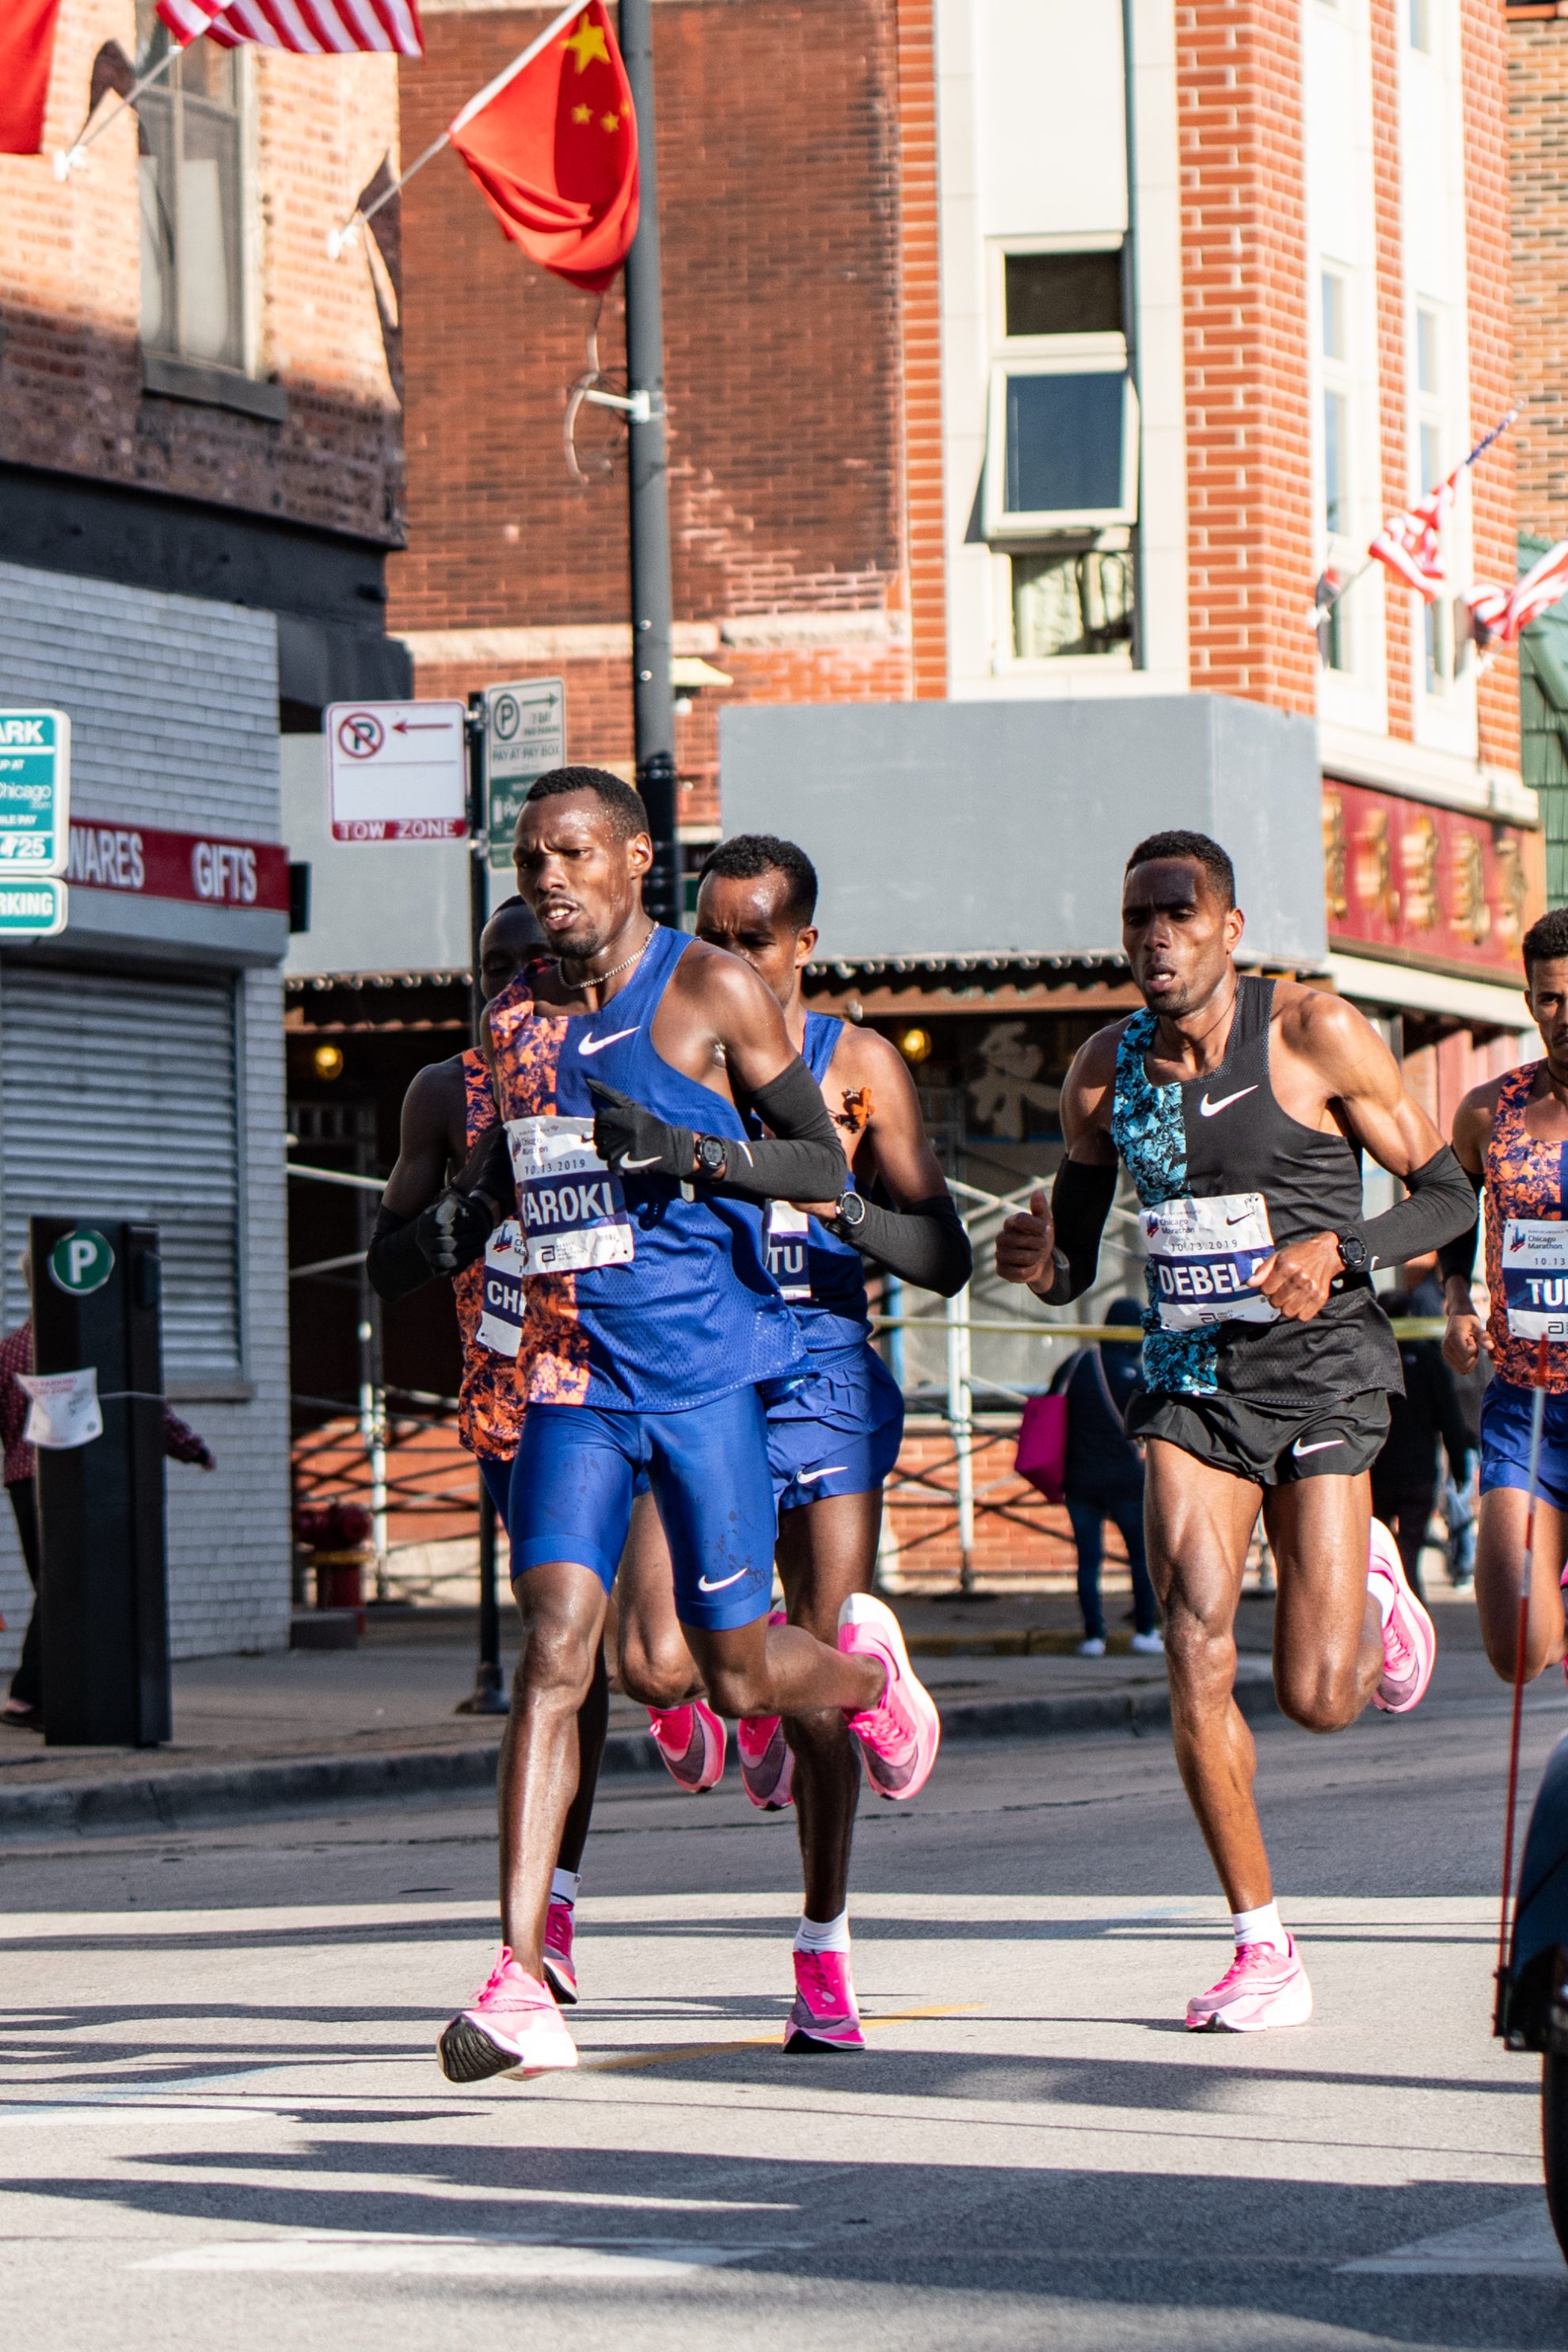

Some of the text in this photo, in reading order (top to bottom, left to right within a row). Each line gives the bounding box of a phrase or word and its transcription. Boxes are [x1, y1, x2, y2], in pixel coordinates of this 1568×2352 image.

[340, 820, 456, 839] TOW ZONE
[192, 841, 257, 904] GIFTS
[524, 1159, 585, 1176] 10.13.2019
